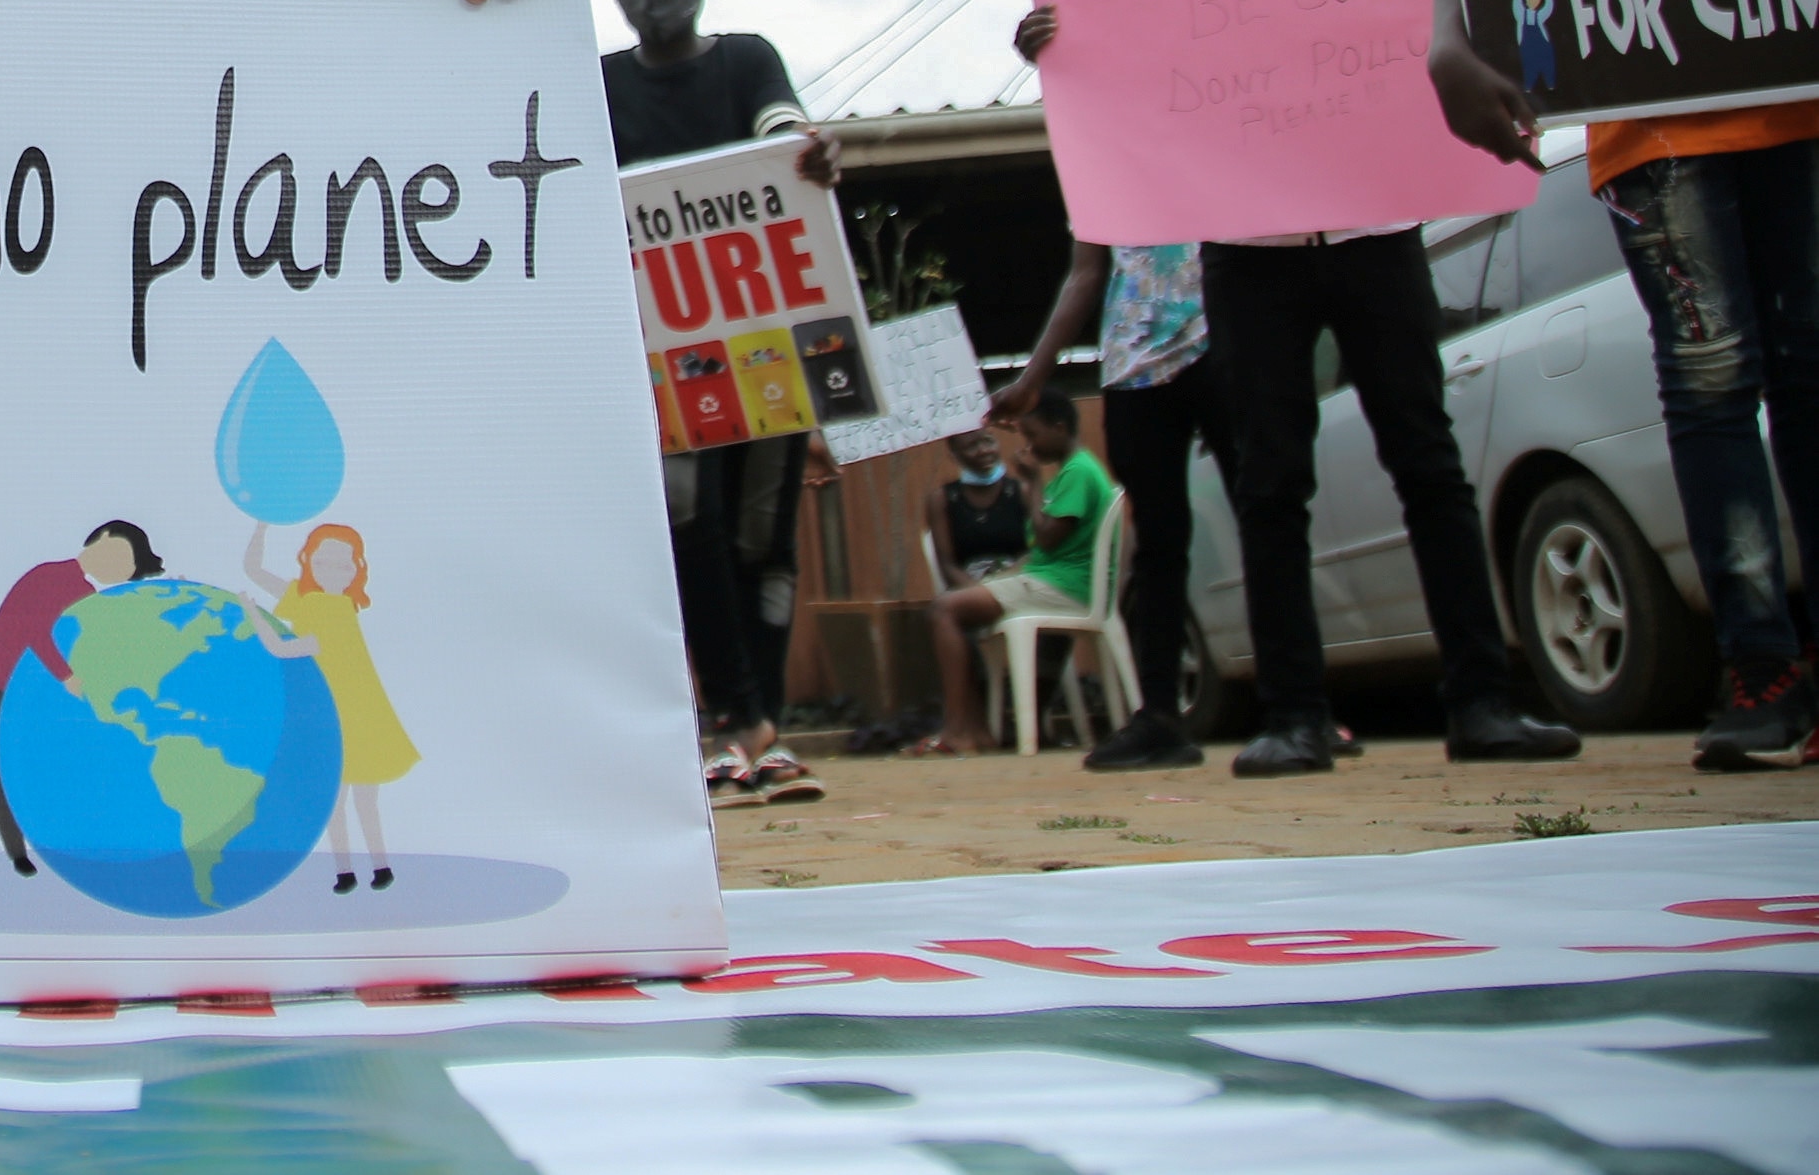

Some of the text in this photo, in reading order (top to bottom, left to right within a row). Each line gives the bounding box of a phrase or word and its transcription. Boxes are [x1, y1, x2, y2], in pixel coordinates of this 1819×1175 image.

[1240, 92, 1351, 146] PLEASE
[132, 66, 583, 373] planet
[636, 203, 674, 244] to
[673, 190, 759, 237] have
[761, 184, 785, 218] a
[633, 218, 826, 333] URE
